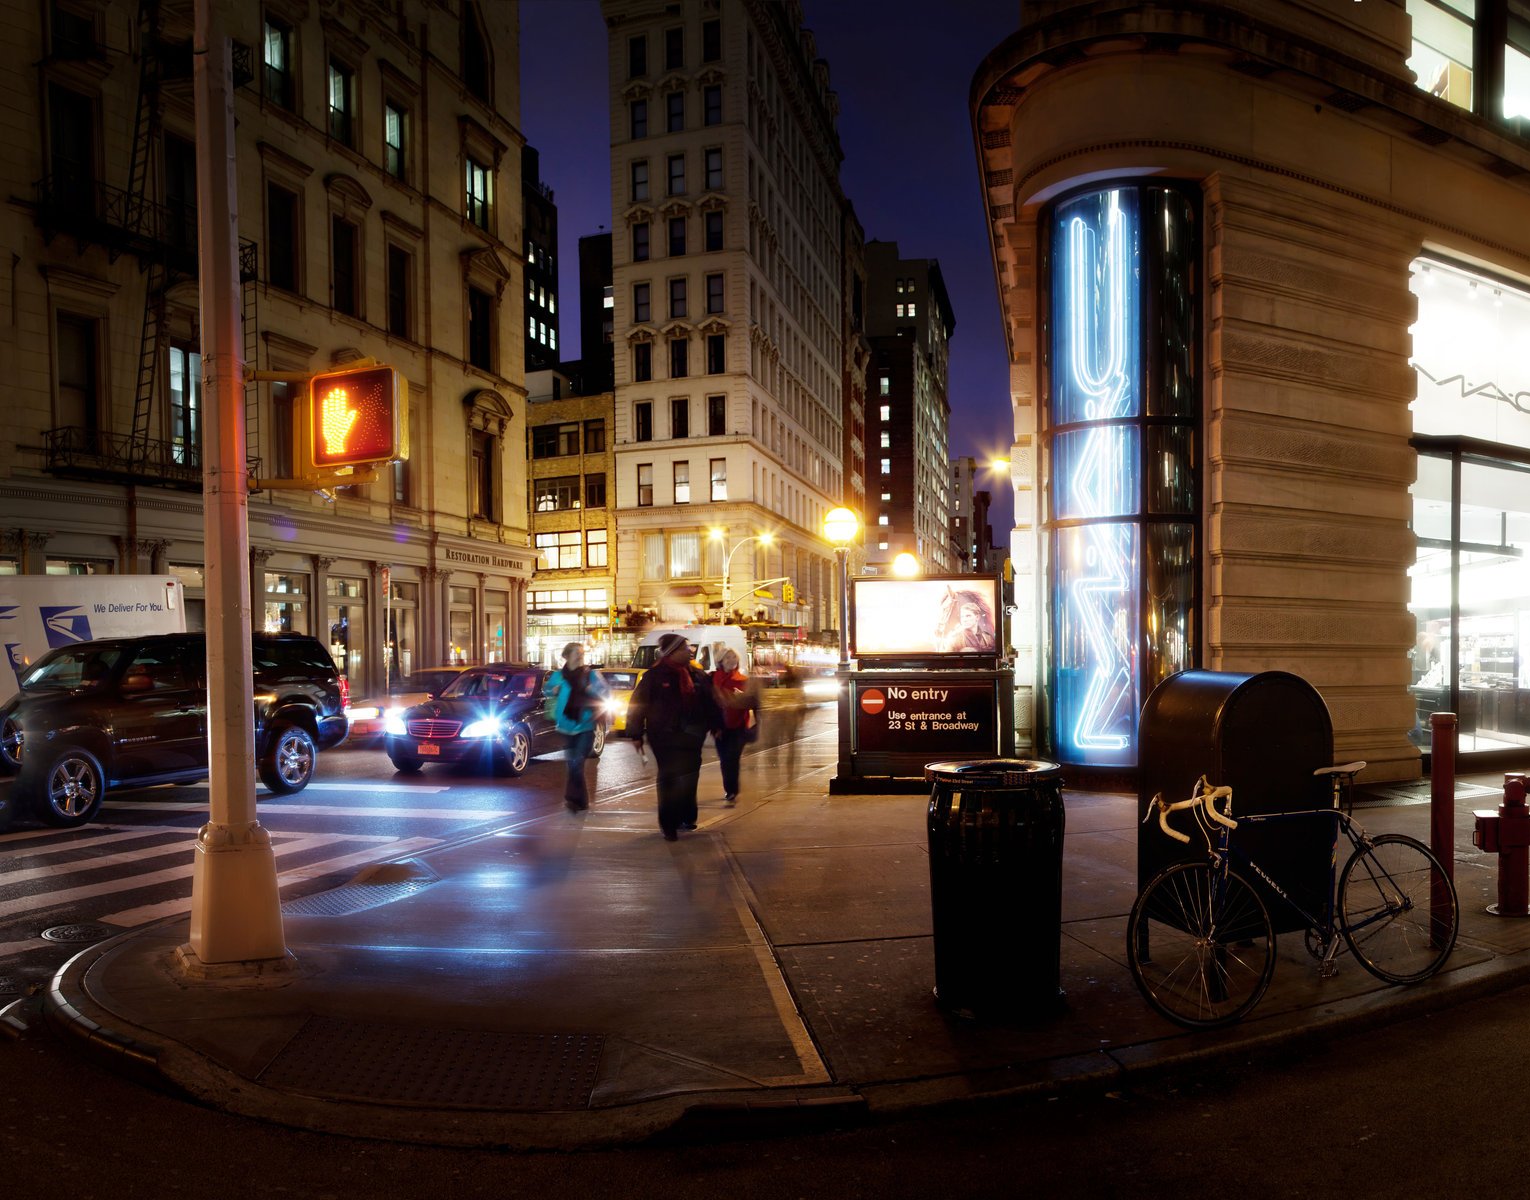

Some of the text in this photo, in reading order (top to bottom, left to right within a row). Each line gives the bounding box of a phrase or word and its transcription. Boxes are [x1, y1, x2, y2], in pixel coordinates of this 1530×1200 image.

[445, 548, 524, 570] RESTORATION HARDWARE
[94, 602, 164, 613] We Deliver For You.
[887, 687, 948, 702] No entry
[888, 711, 967, 720] Use entrance at
[888, 721, 979, 731] 23 St & Broadway
